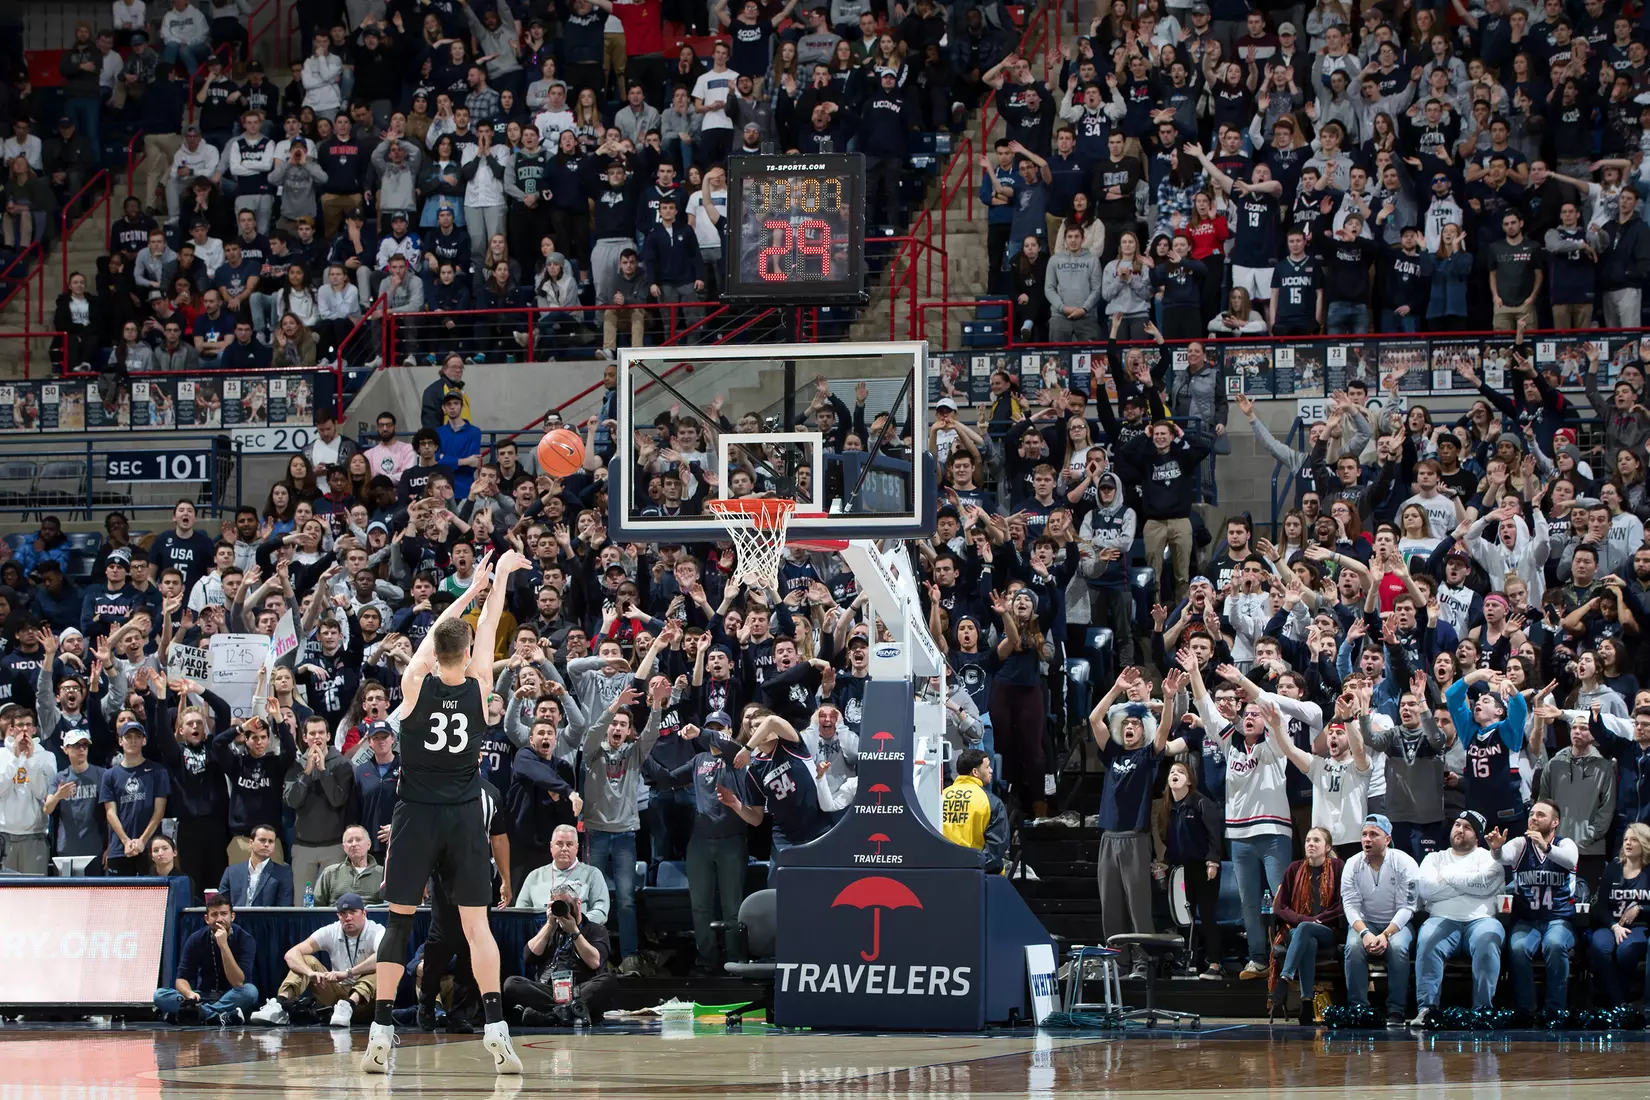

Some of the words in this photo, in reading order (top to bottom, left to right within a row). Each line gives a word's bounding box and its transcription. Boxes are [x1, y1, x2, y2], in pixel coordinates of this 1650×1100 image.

[873, 100, 900, 113] UCONN
[1085, 125, 1101, 136] 34
[525, 179, 537, 194] 8
[1244, 202, 1268, 212] UCONN
[1248, 212, 1259, 227] 13
[120, 231, 148, 243] UCONN
[759, 220, 831, 281] 29
[1058, 262, 1090, 270] UCONN
[1113, 270, 1141, 279] UNN
[1281, 276, 1312, 287] UCONN
[1290, 287, 1302, 304] 15
[1281, 350, 1289, 359] 31
[1332, 348, 1341, 358] 23
[45, 386, 57, 396] 50
[136, 385, 146, 393] 52
[228, 382, 237, 391] 25
[1301, 405, 1323, 419] SE
[234, 434, 265, 448] SEC
[273, 429, 320, 451] 20
[109, 461, 143, 476] SEC
[156, 455, 207, 480] 101
[170, 548, 194, 561] USA
[95, 604, 130, 615] UCONN
[1439, 593, 1469, 613] UCONN
[184, 646, 207, 659] WERE
[185, 667, 208, 680] ING
[315, 676, 345, 691] UCONN
[324, 690, 340, 712] 15
[442, 700, 458, 710] VOGT
[424, 711, 469, 754] 33
[857, 751, 905, 761] TRAVELERS
[1229, 757, 1259, 774] UCONN
[1471, 757, 1490, 778] 15
[238, 776, 270, 789] UCONN
[769, 774, 797, 801] 34
[945, 789, 973, 799] CSC
[854, 805, 904, 814] TRAVELERS
[943, 800, 970, 812] EVENT
[943, 811, 969, 823] STAFF
[853, 854, 903, 864] TRAVELERS
[1518, 870, 1565, 886] CONNECTICUT
[1530, 885, 1553, 911] 34
[776, 963, 972, 997] TRAVELERS
[1032, 972, 1059, 998] WHITE
